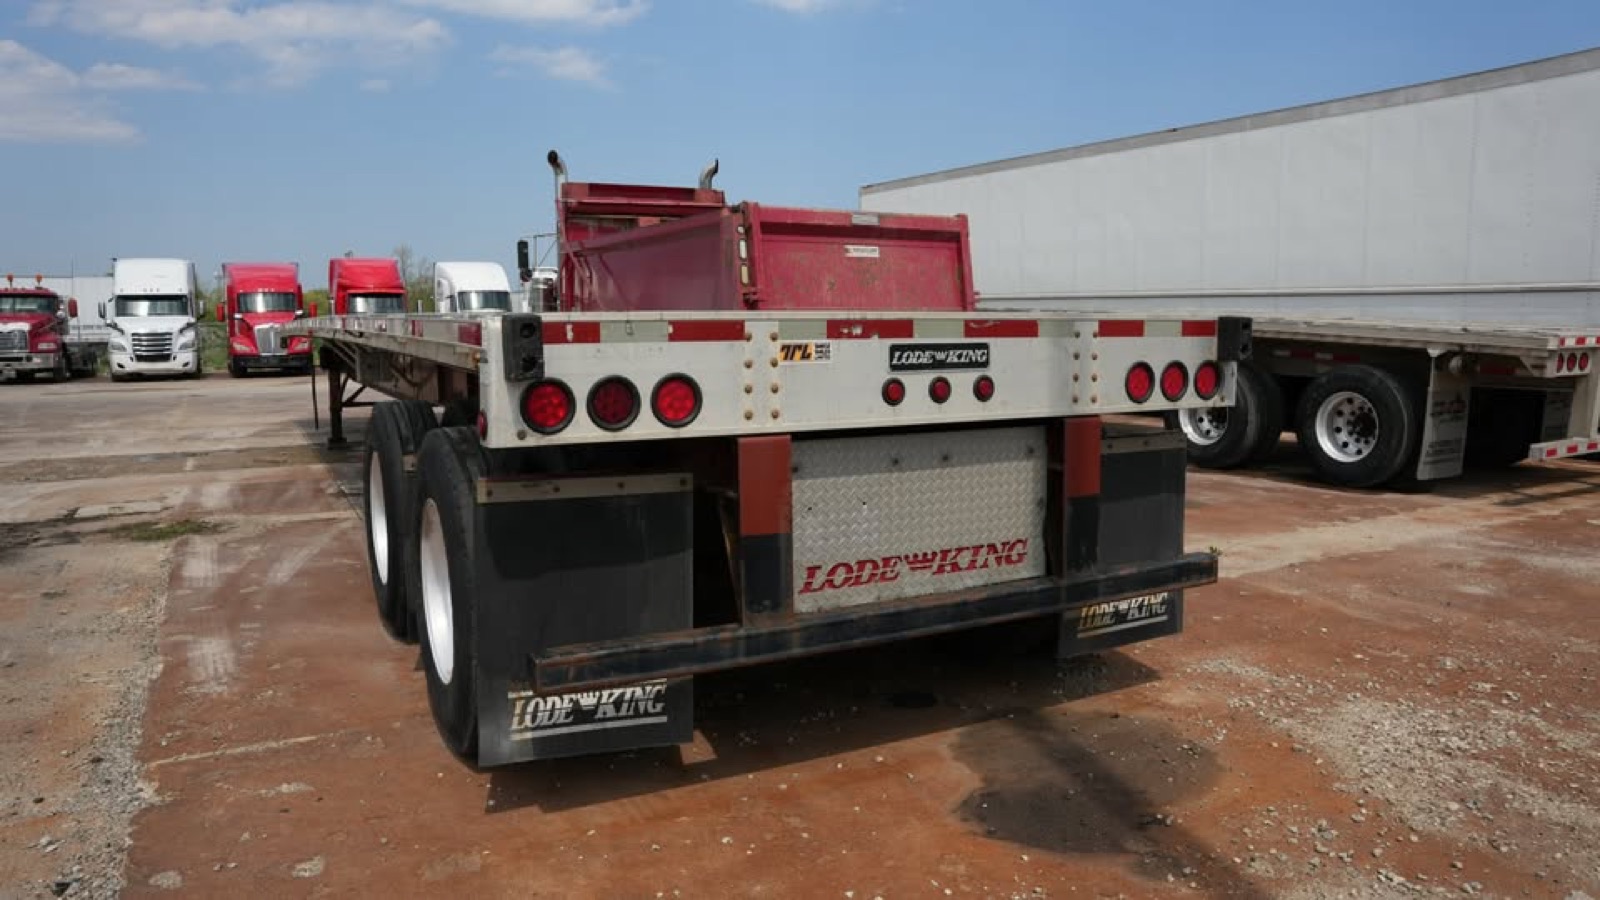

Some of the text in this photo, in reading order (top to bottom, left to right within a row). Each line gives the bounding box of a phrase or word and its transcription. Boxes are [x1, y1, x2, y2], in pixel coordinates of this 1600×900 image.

[891, 349, 988, 365] LODE KING
[799, 538, 1029, 595] LODE KING
[1080, 592, 1168, 628] LODE KING
[511, 684, 668, 730] LODE KING
